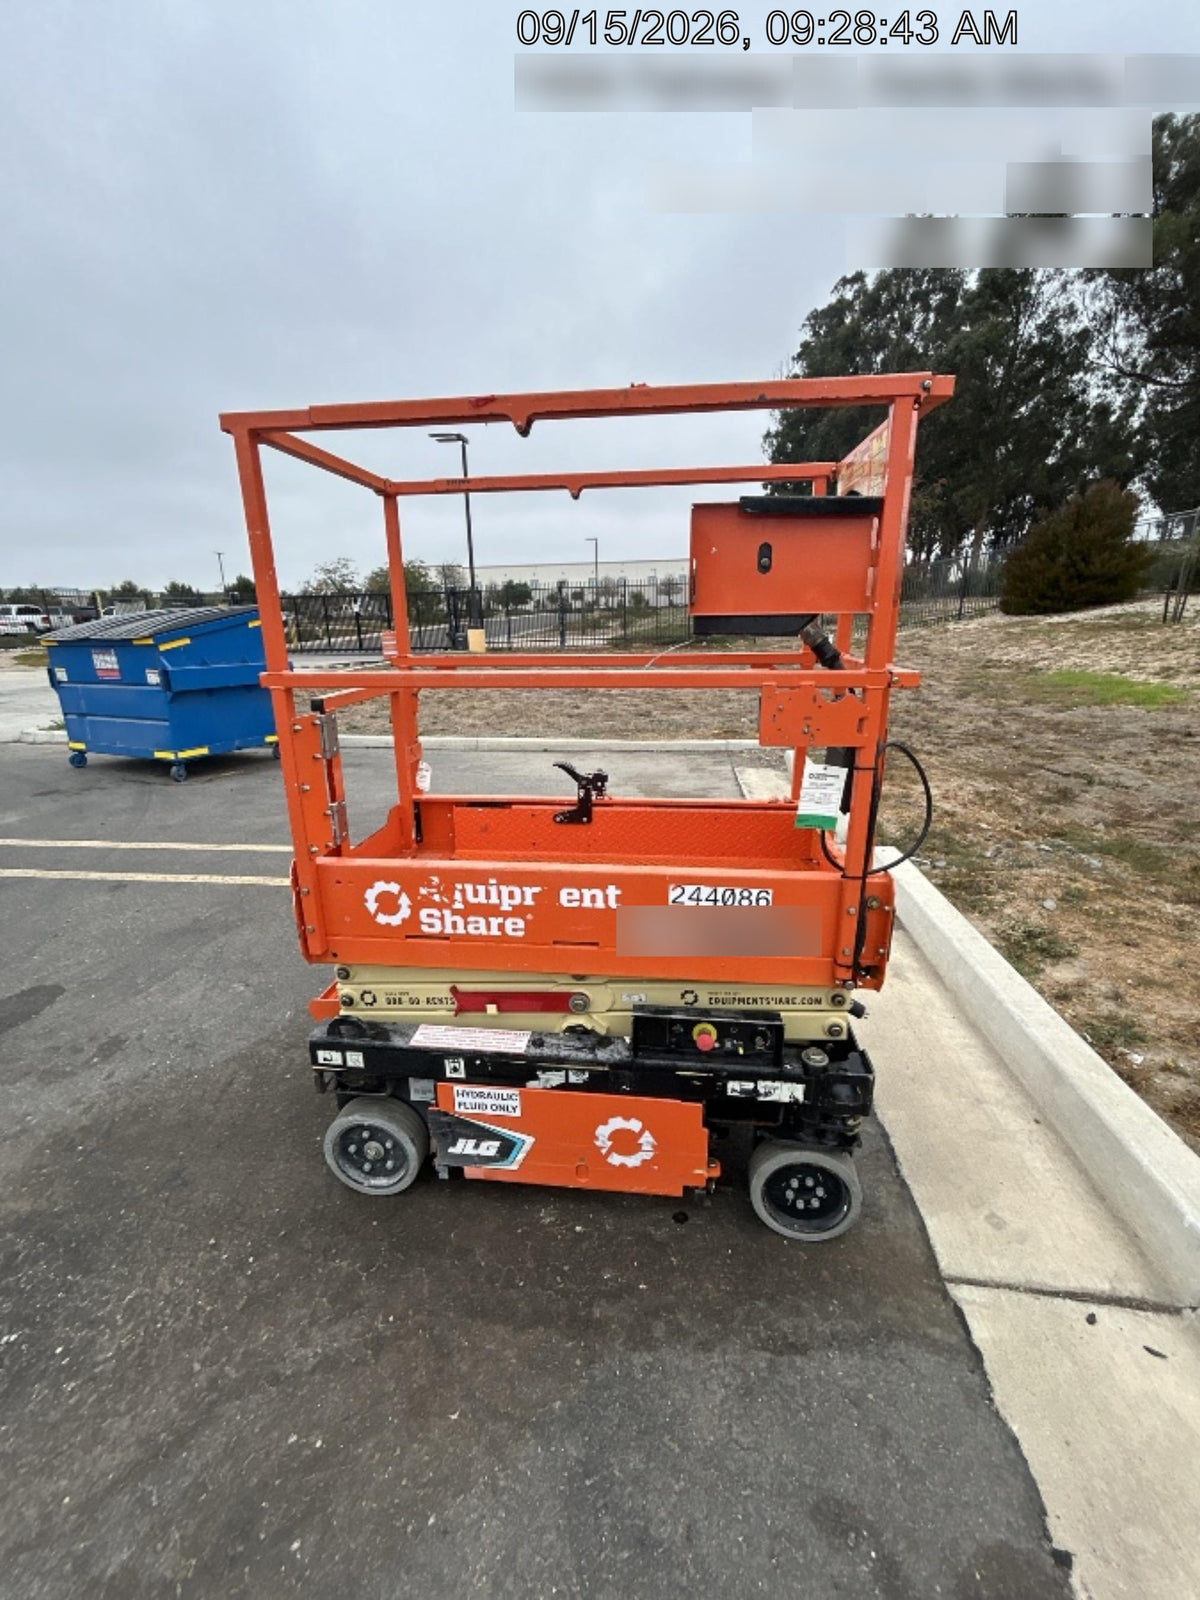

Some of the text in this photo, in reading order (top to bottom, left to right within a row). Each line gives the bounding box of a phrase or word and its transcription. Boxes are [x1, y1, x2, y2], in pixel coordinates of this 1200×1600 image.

[671, 885, 771, 906] 244086
[418, 908, 526, 937] Share
[456, 1089, 519, 1102] HYDRAULIC
[458, 1101, 519, 1114] FLUID ONLY
[447, 1138, 502, 1157] JLG
